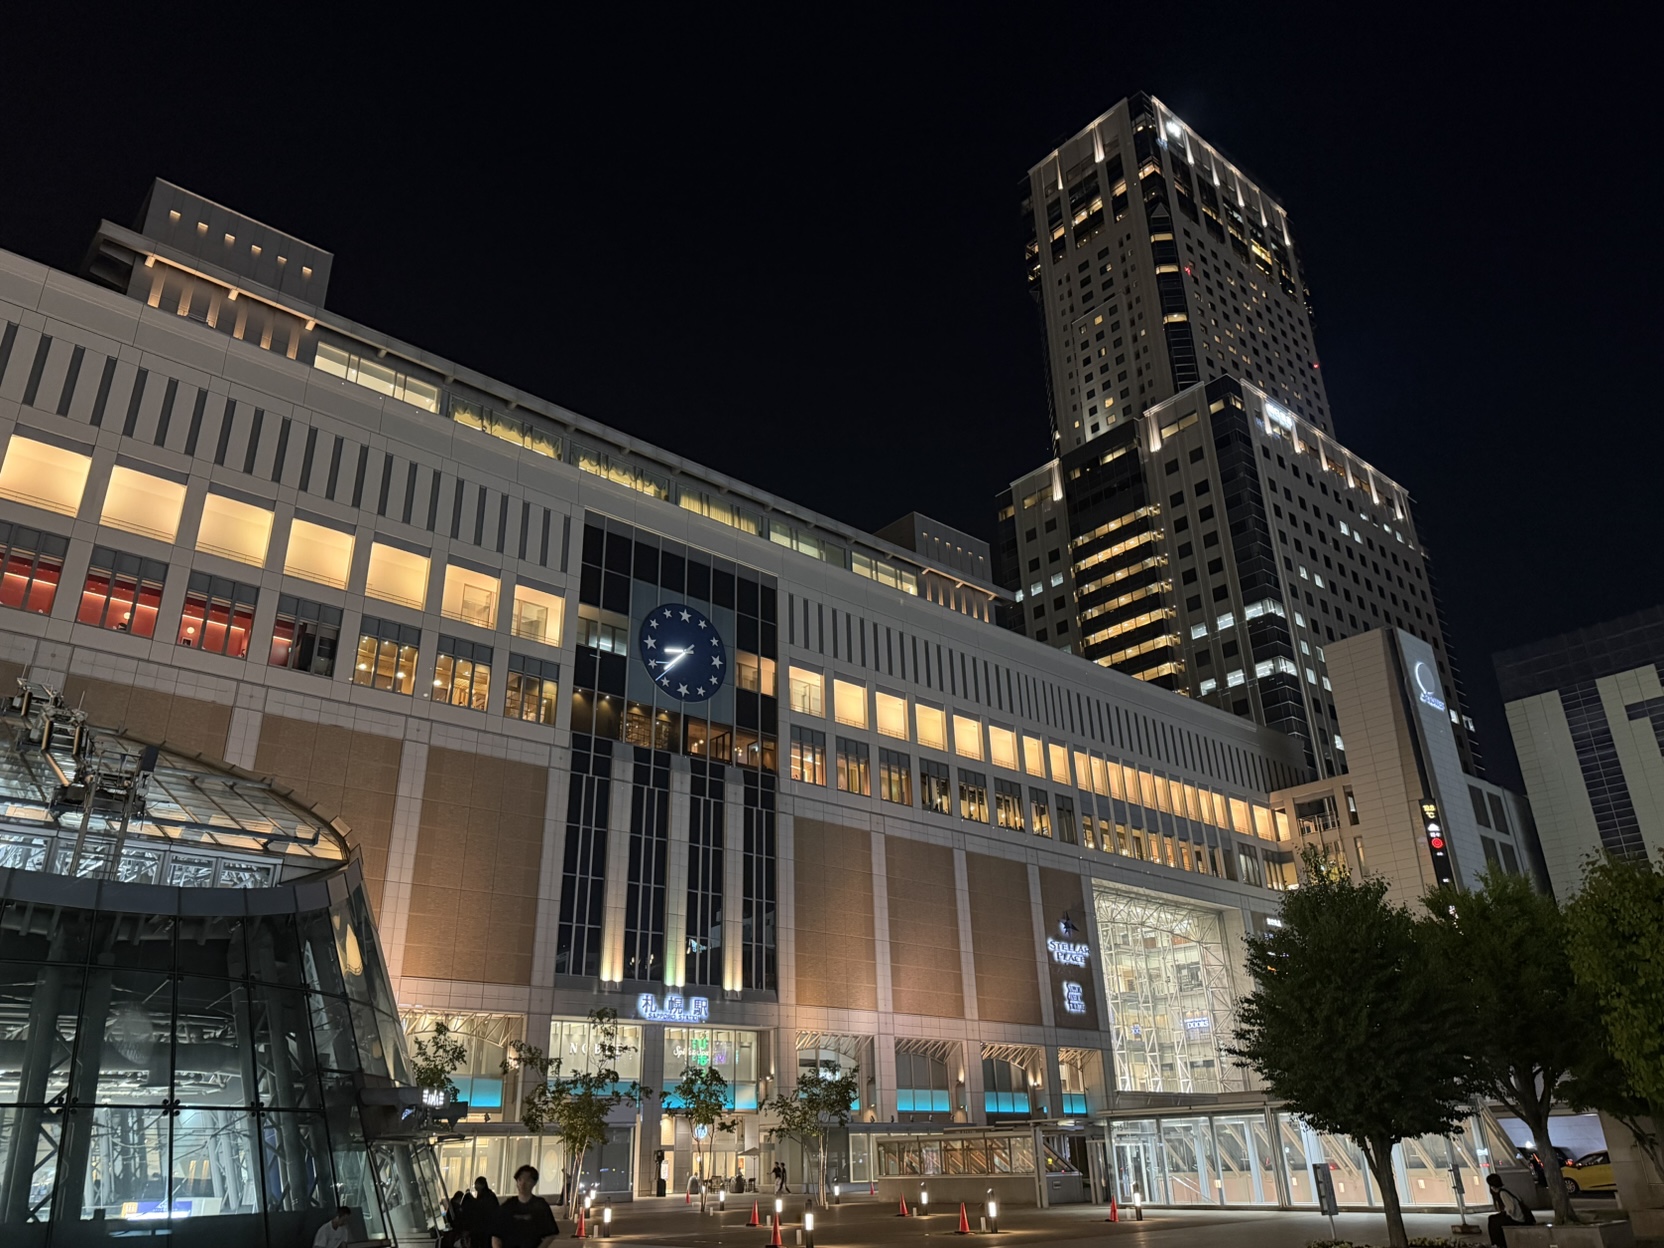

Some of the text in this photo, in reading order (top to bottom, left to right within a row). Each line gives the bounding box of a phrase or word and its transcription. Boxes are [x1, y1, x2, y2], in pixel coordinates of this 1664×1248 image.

[1049, 940, 1091, 954] STELLAR
[1056, 952, 1087, 963] PLACE
[642, 994, 709, 1017] 札幌駅
[1187, 1020, 1209, 1029] DOORS
